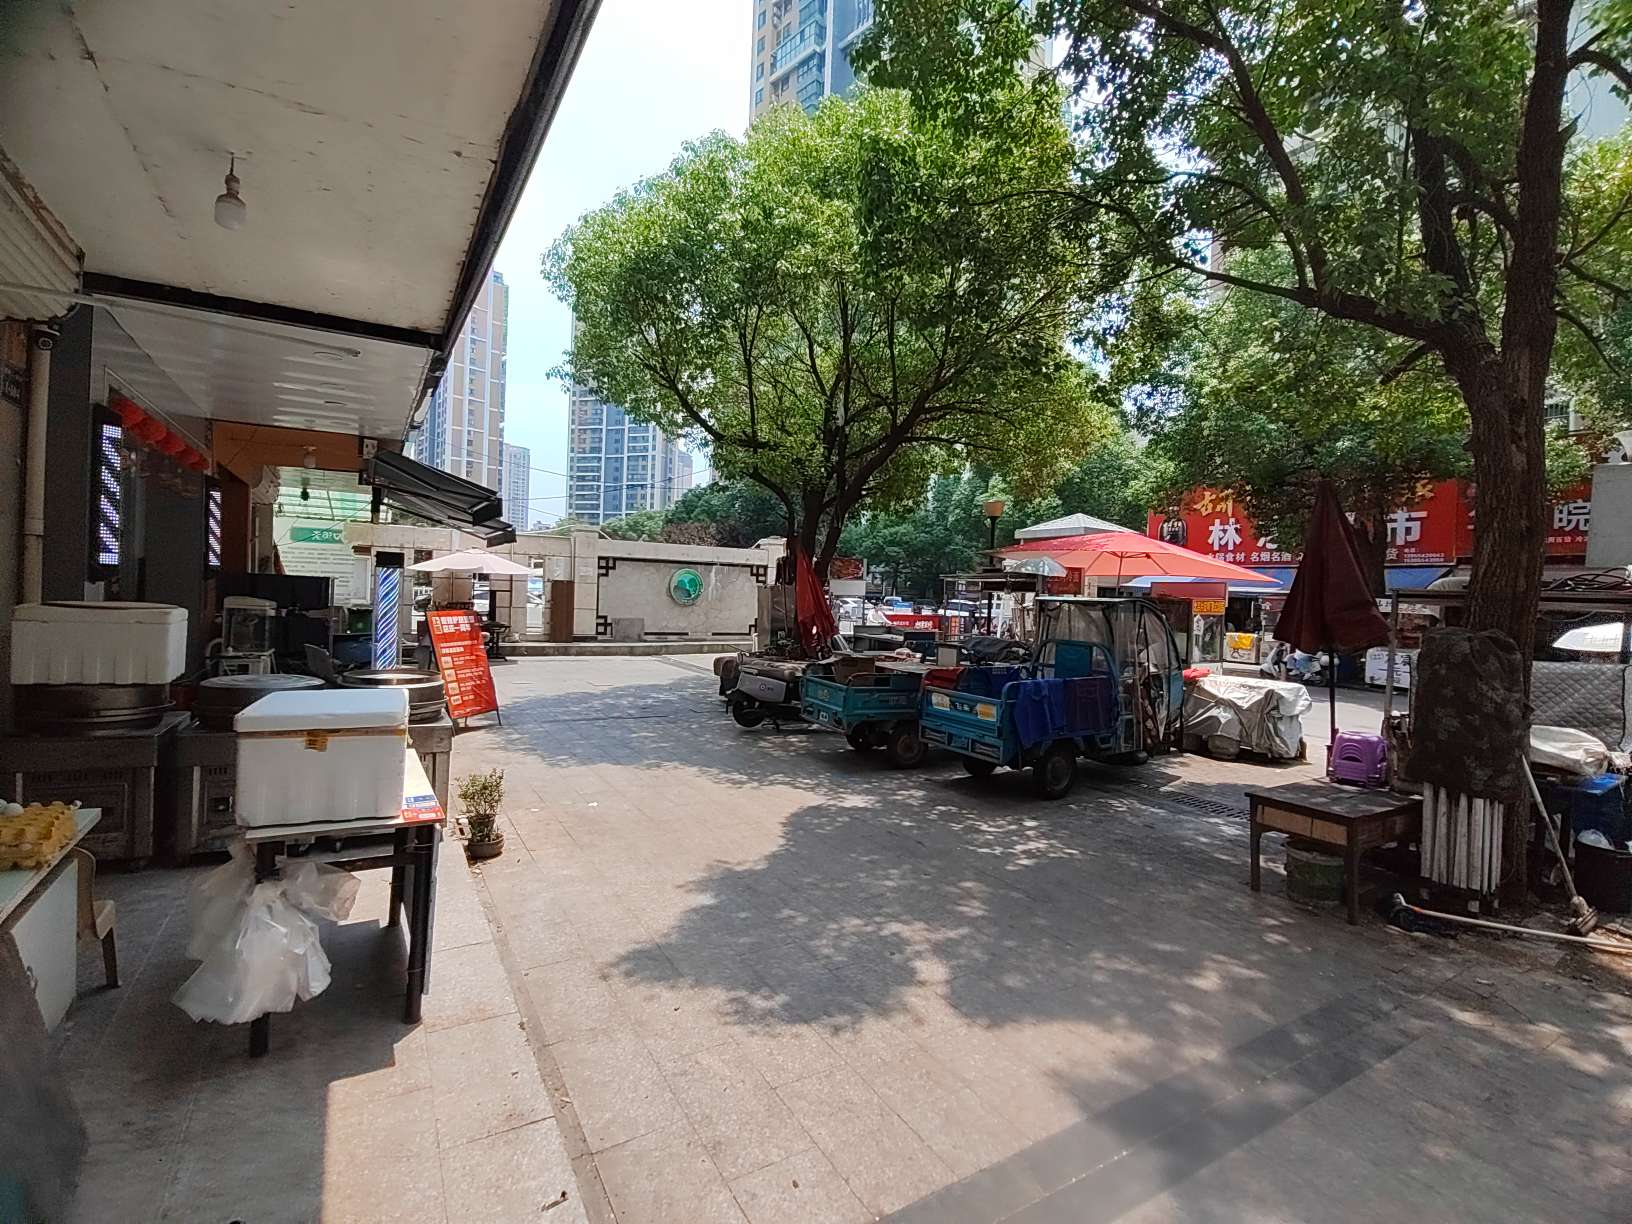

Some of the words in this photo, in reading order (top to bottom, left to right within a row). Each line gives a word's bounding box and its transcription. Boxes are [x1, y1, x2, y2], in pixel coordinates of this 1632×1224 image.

[1384, 507, 1428, 546] 市
[1250, 552, 1292, 562] 名烟名酒
